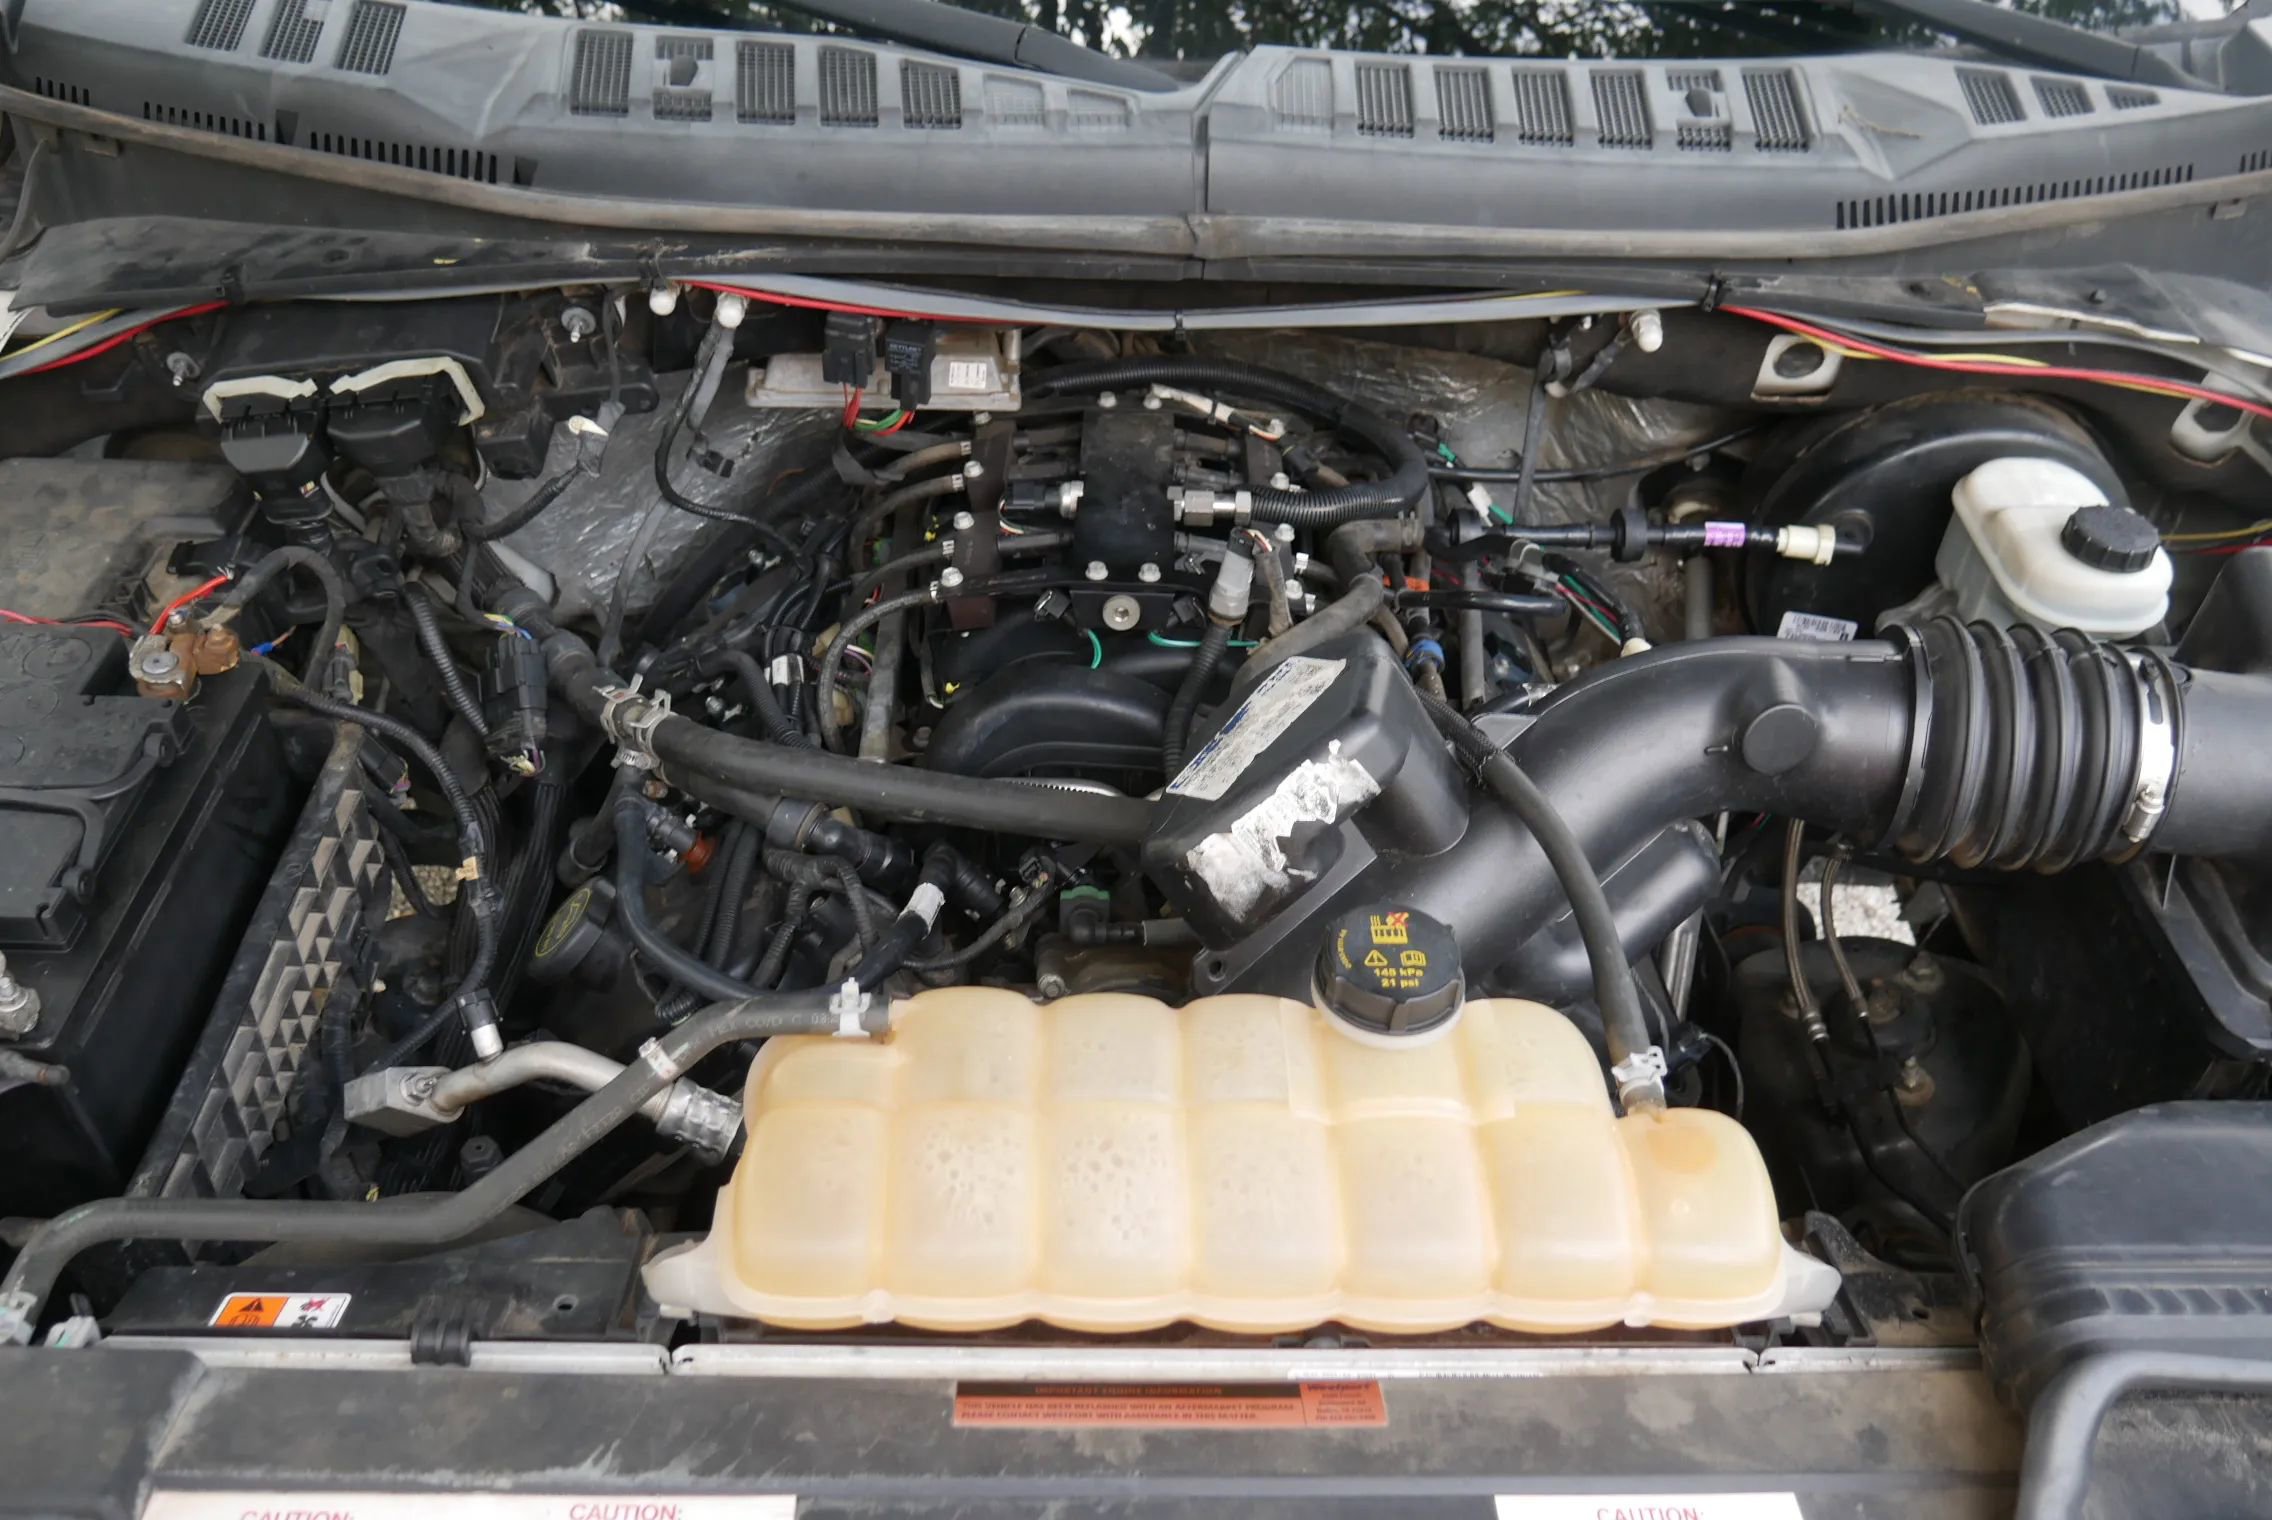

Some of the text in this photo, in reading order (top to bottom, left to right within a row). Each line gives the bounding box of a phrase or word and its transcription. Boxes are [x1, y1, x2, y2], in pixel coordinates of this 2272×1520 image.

[1399, 968, 1424, 977] kPa
[1381, 978, 1419, 989] 21 psi
[569, 1503, 681, 1520] CAUTION:
